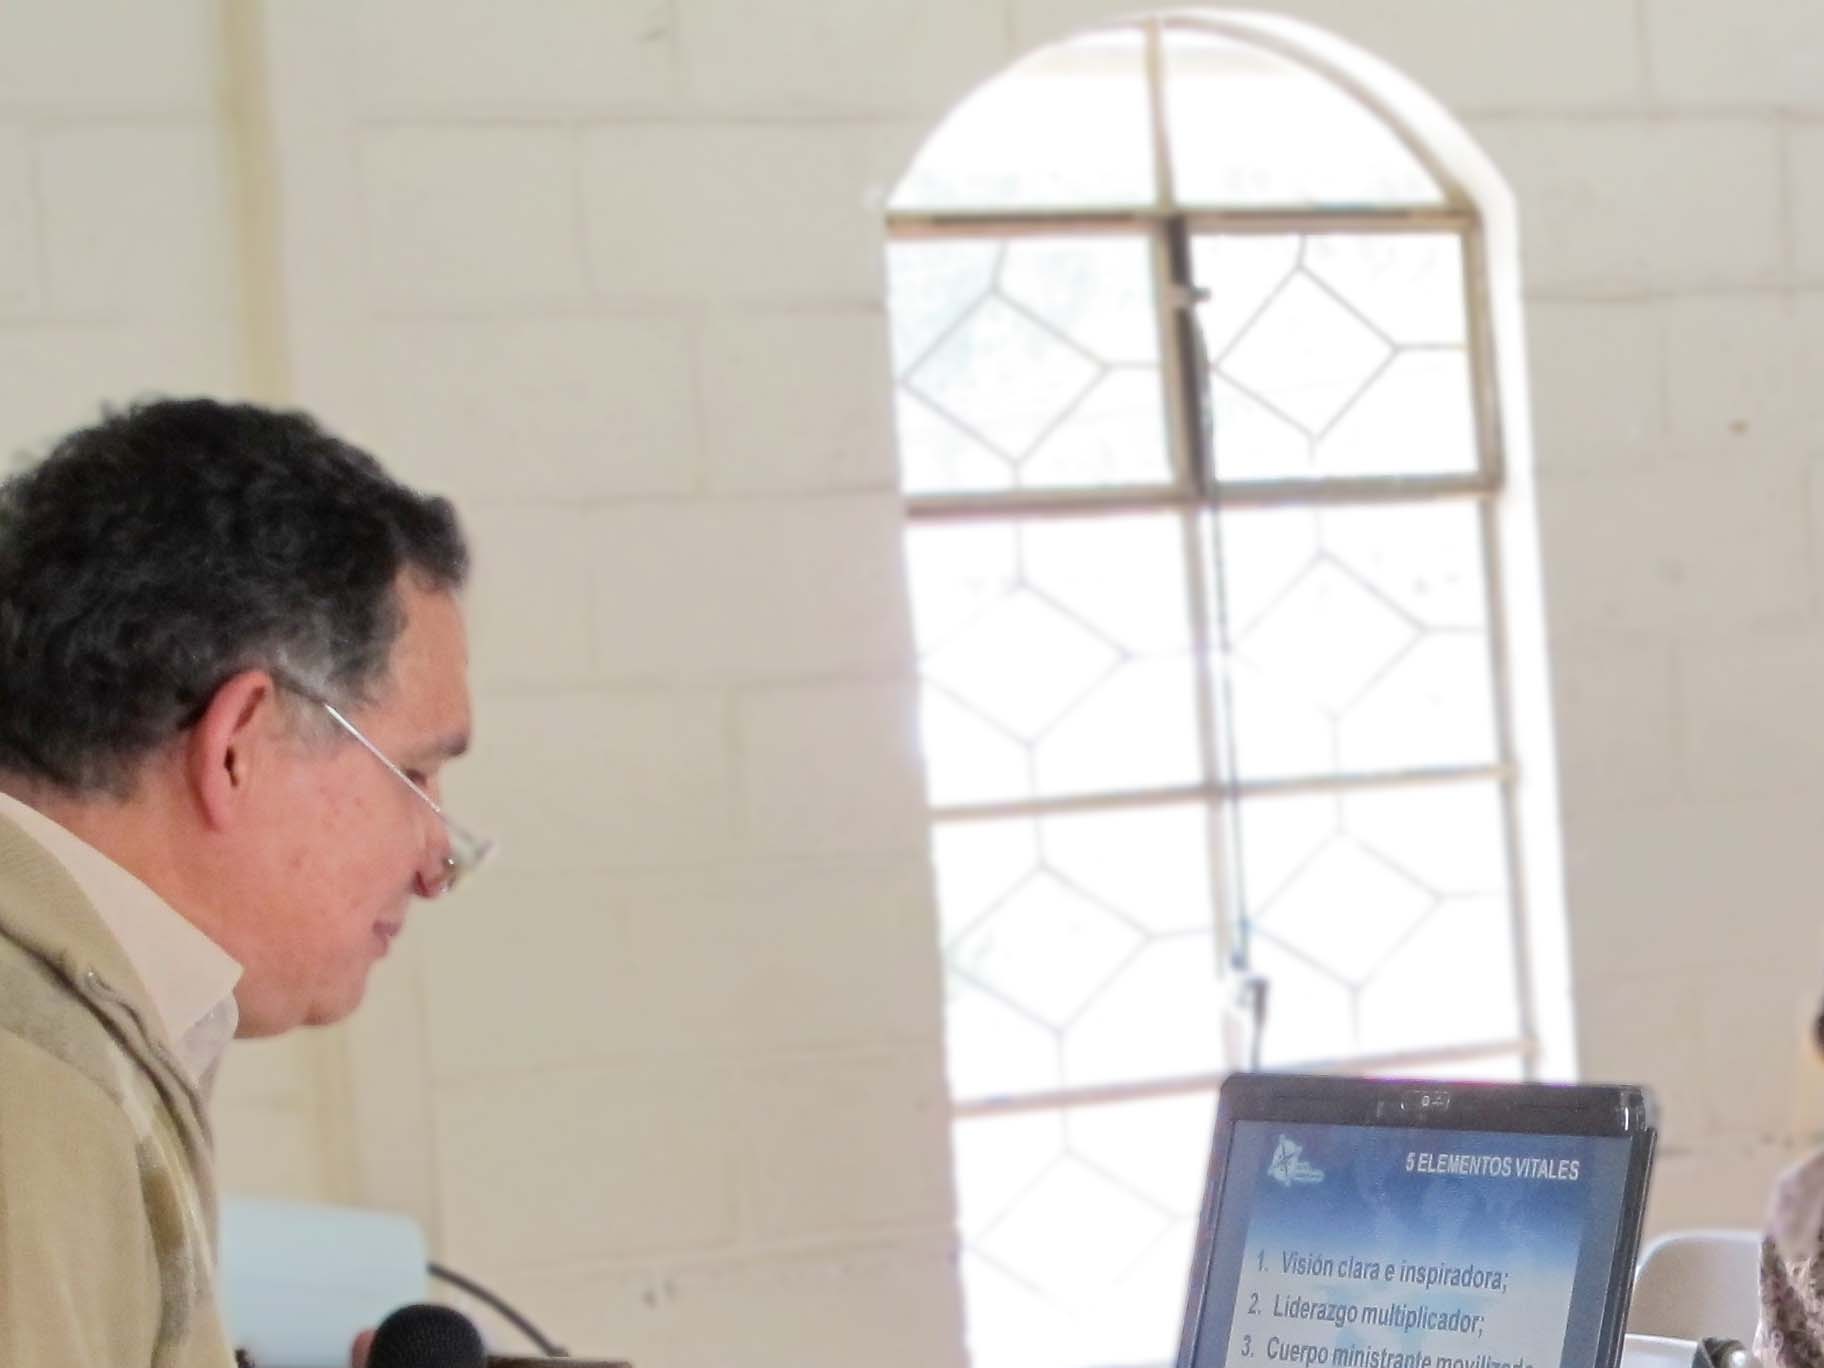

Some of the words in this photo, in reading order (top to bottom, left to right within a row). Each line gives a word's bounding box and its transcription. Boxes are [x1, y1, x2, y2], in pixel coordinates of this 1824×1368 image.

[1405, 1152, 1416, 1172] 5
[1417, 1152, 1513, 1178] ELEMENTOS
[1512, 1157, 1580, 1182] VITALES
[1257, 1249, 1269, 1273] 1.
[1282, 1250, 1334, 1277] Visión
[1338, 1255, 1380, 1281] clara
[1384, 1263, 1396, 1282] e
[1400, 1260, 1509, 1294] inspiradora;
[1248, 1292, 1261, 1316] 2.
[1273, 1293, 1358, 1328] Liderazgo
[1361, 1303, 1485, 1338] multiplicador;
[1241, 1334, 1254, 1358] 3.
[1266, 1336, 1329, 1368] Cuerpo
